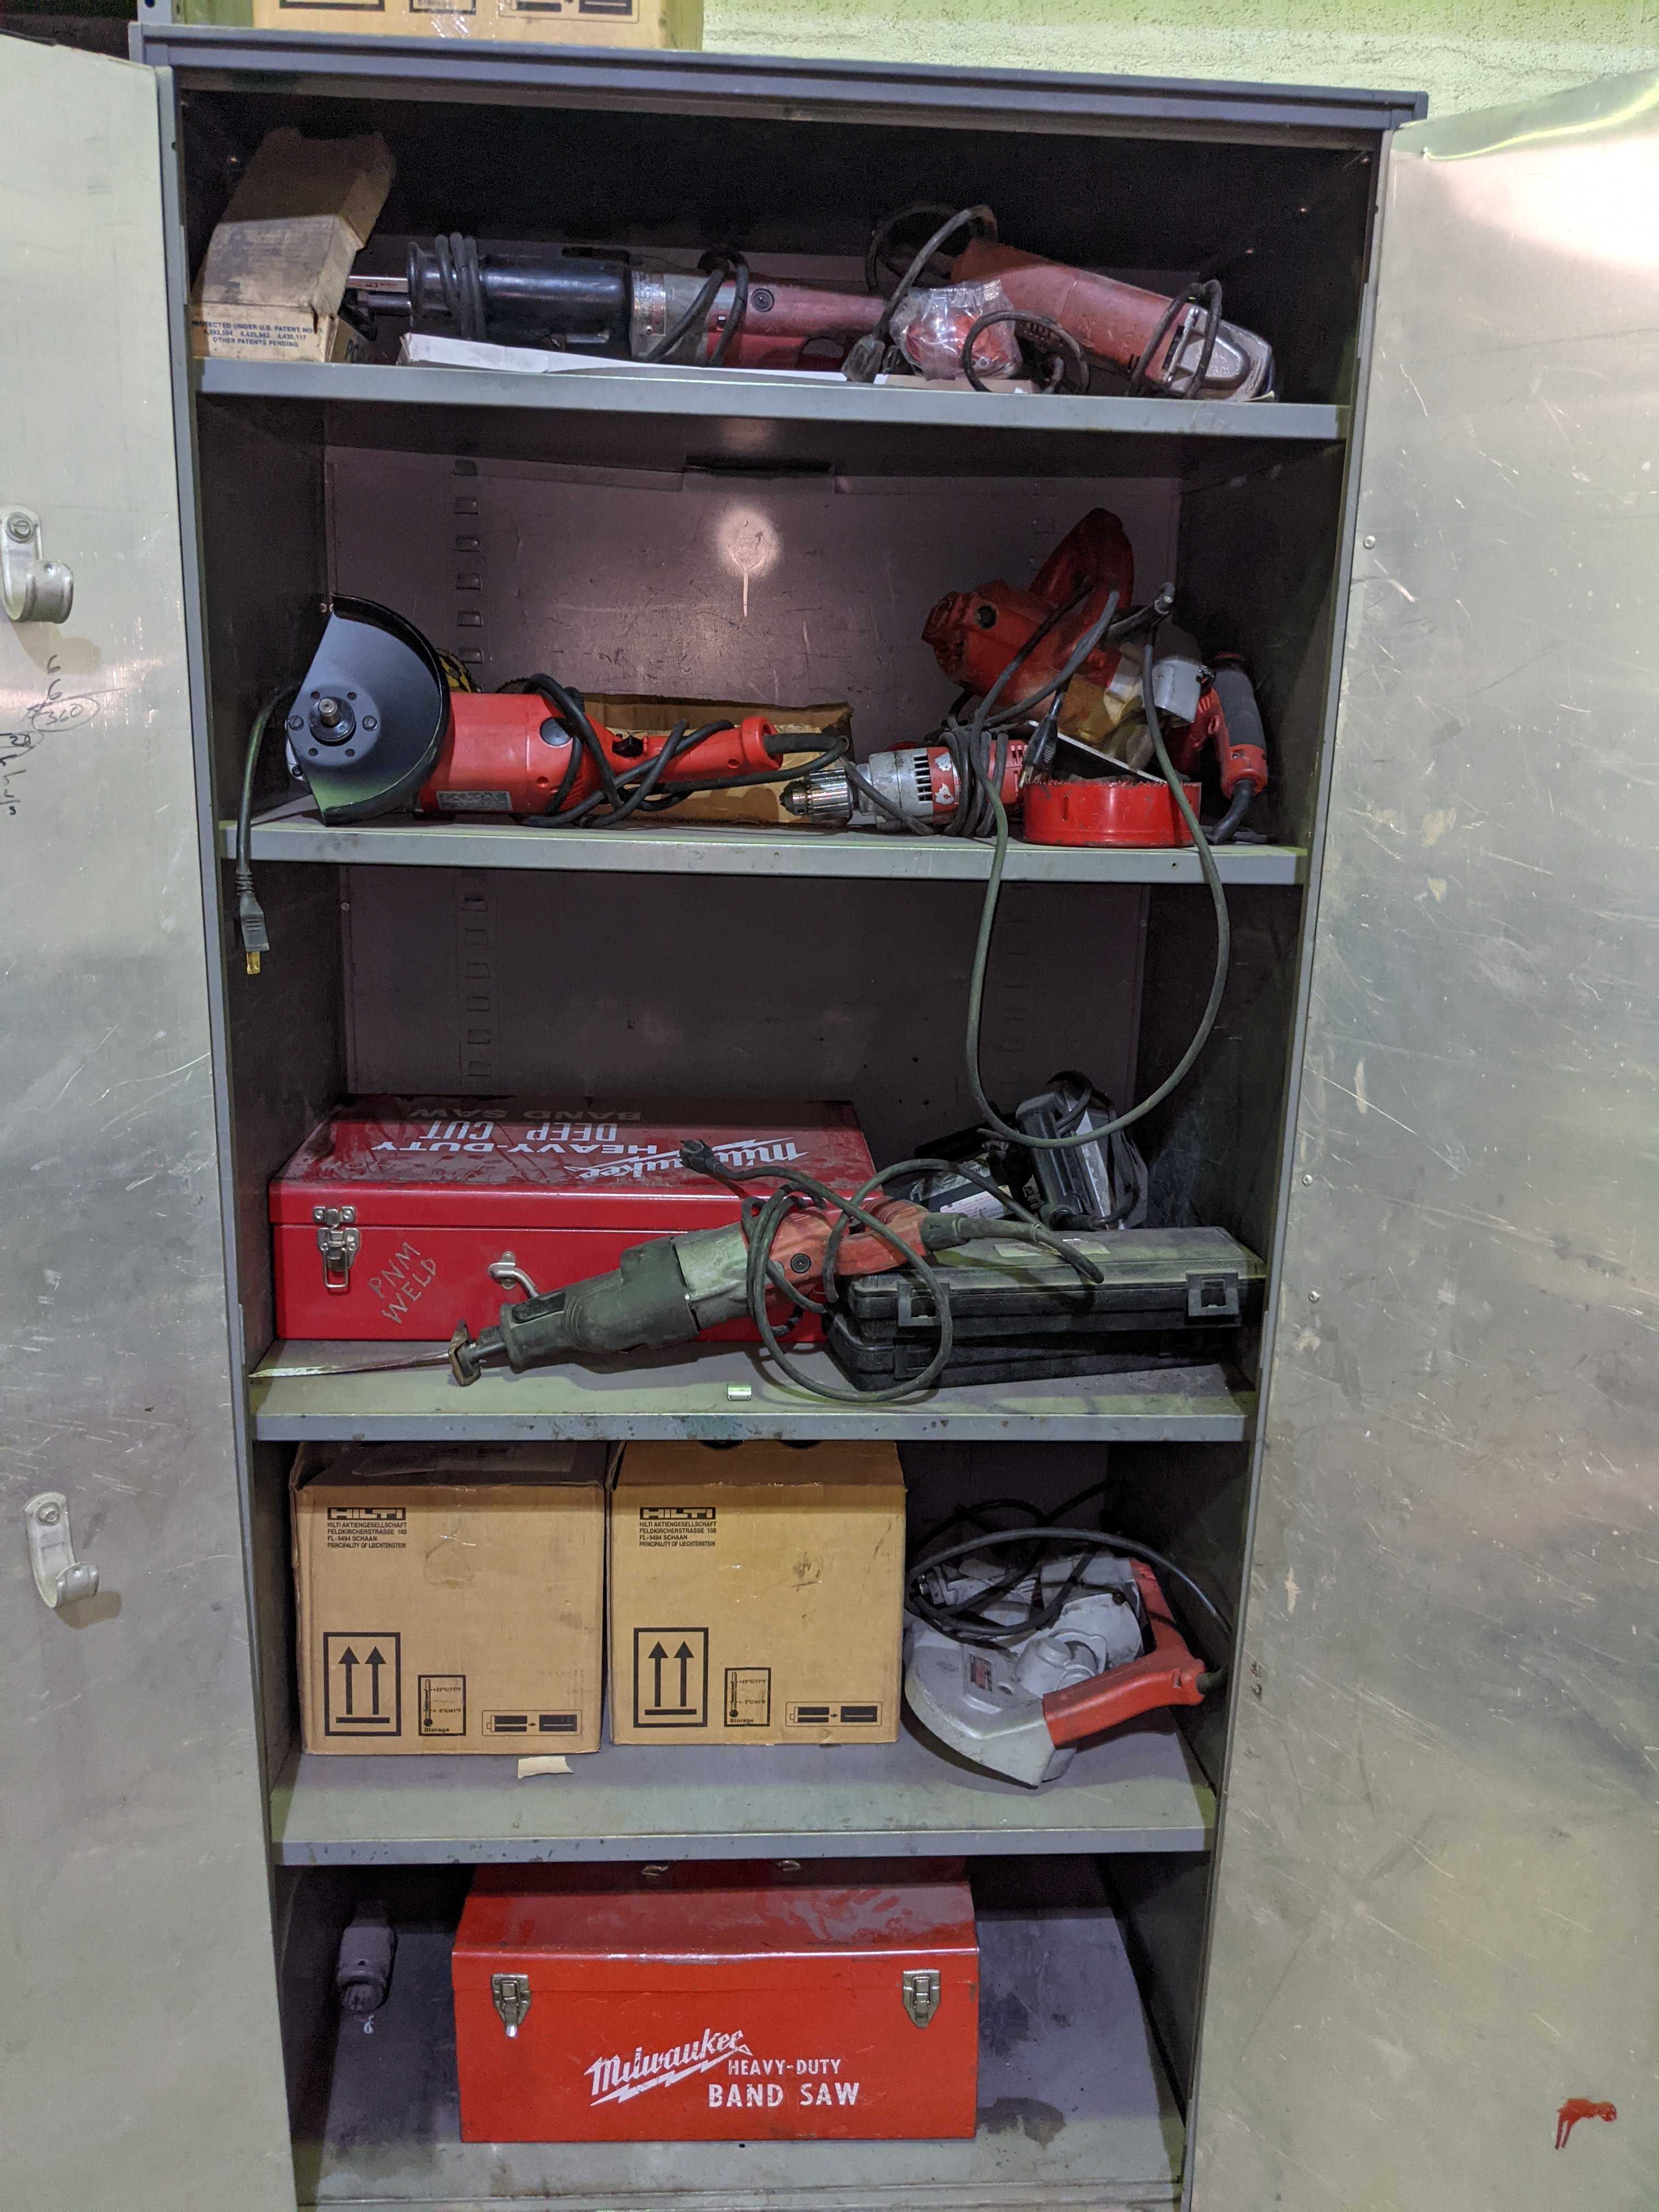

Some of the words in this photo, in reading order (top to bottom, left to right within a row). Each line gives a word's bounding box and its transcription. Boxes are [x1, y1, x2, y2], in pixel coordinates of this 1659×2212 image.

[408, 1109, 508, 1118] SAW
[522, 1110, 641, 1120] BAND
[419, 1120, 495, 1139] CUT
[526, 1122, 618, 1142] DEEP
[371, 1142, 657, 1154] HEAVY-DUTY
[565, 1139, 809, 1178] Milukee
[369, 1242, 421, 1299] PNM
[381, 1259, 436, 1323] WELD
[329, 1508, 405, 1520] HILTI
[641, 1508, 714, 1519] HILTI
[584, 2028, 752, 2098] Milwaukee
[728, 2059, 840, 2075] HEAVY-DUTY
[708, 2083, 784, 2107] BAND
[800, 2083, 860, 2106] SAW
